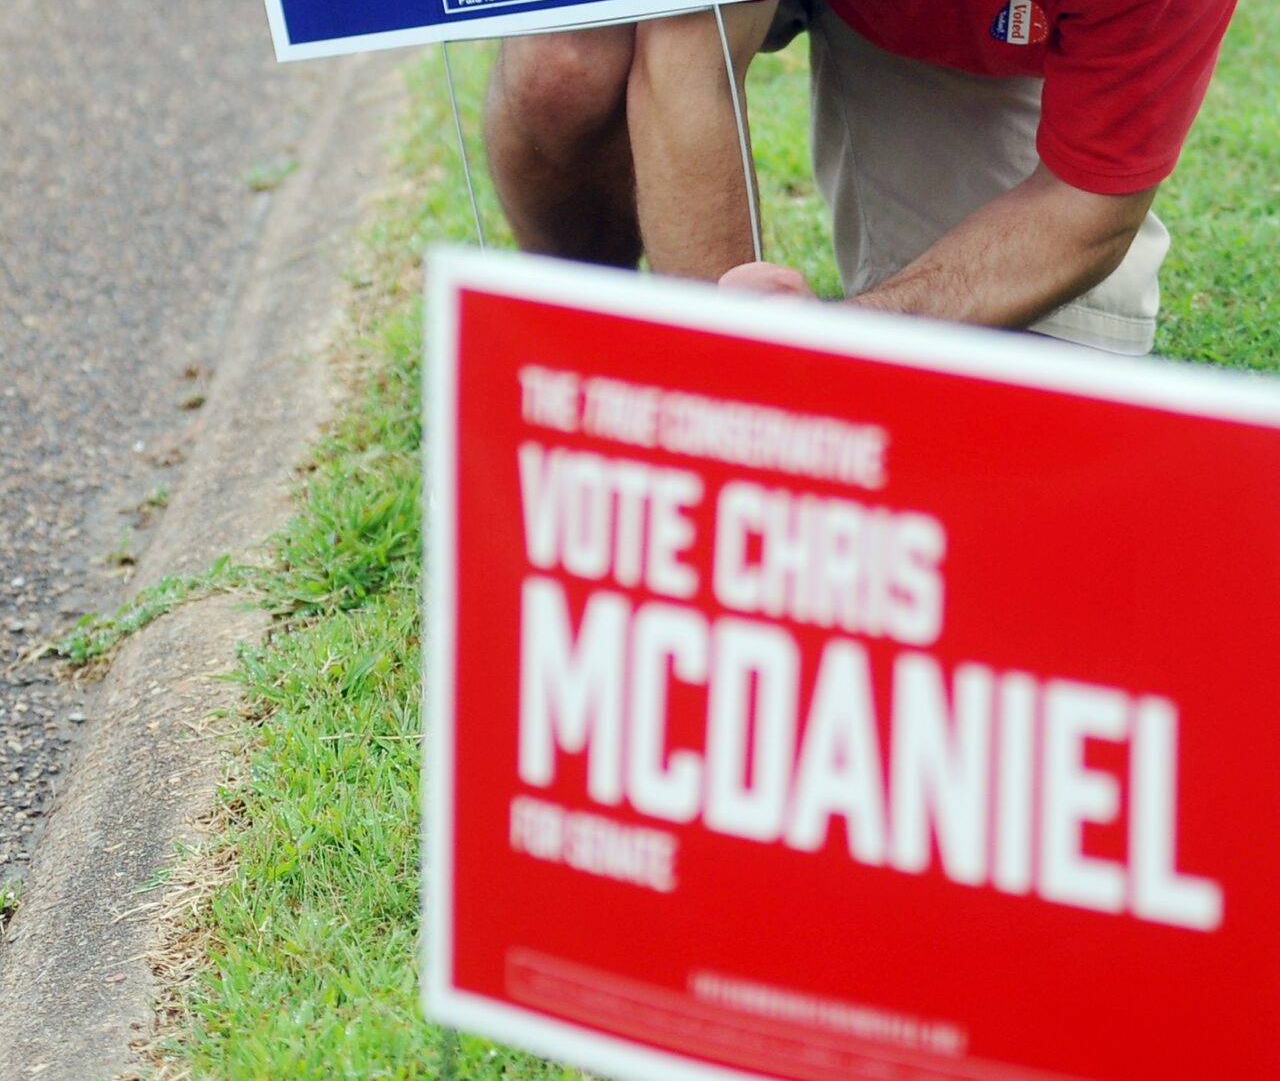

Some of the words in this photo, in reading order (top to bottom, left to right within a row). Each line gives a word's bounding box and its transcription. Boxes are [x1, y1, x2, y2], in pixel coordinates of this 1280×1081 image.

[1011, 4, 1027, 39] Voted
[516, 440, 704, 599] VOTE
[712, 479, 947, 646] CHRIS
[516, 576, 1226, 933] MCDANIEL
